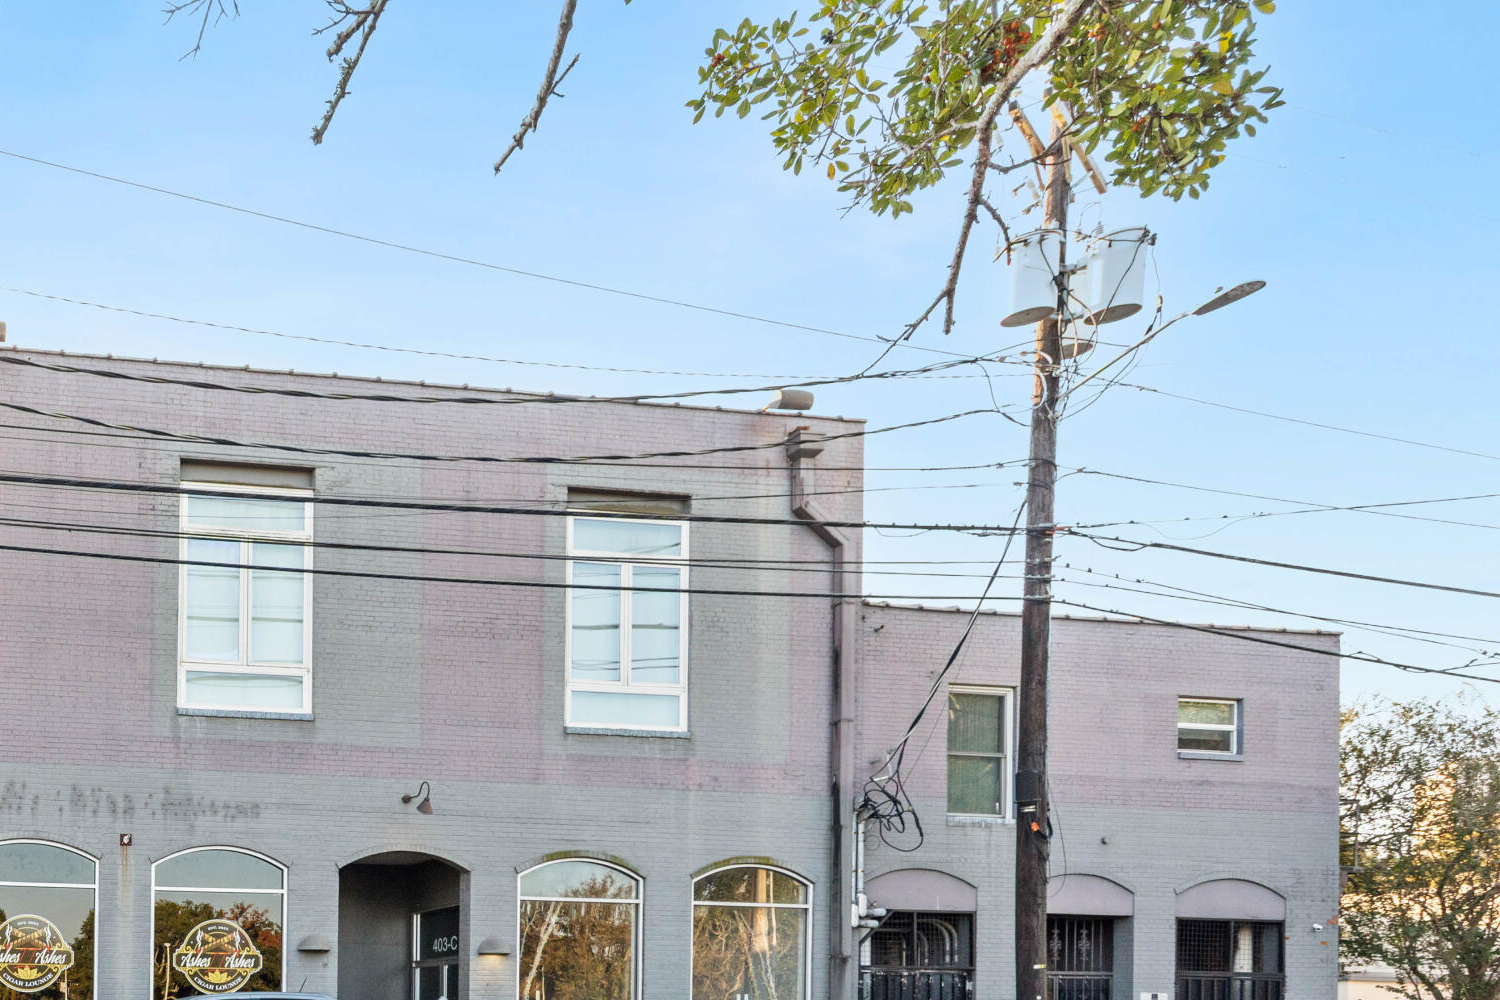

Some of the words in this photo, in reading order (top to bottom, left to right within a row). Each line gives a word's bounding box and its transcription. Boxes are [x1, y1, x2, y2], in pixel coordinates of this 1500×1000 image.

[432, 935, 458, 953] 403-C
[34, 944, 66, 964] Ashes
[180, 949, 212, 968] Ashes
[224, 949, 255, 968] Ashes
[2, 972, 24, 986] CIGAR
[25, 972, 54, 987] LOUNGE
[193, 976, 215, 990] CIGAR
[215, 976, 243, 991] LOUNGE
